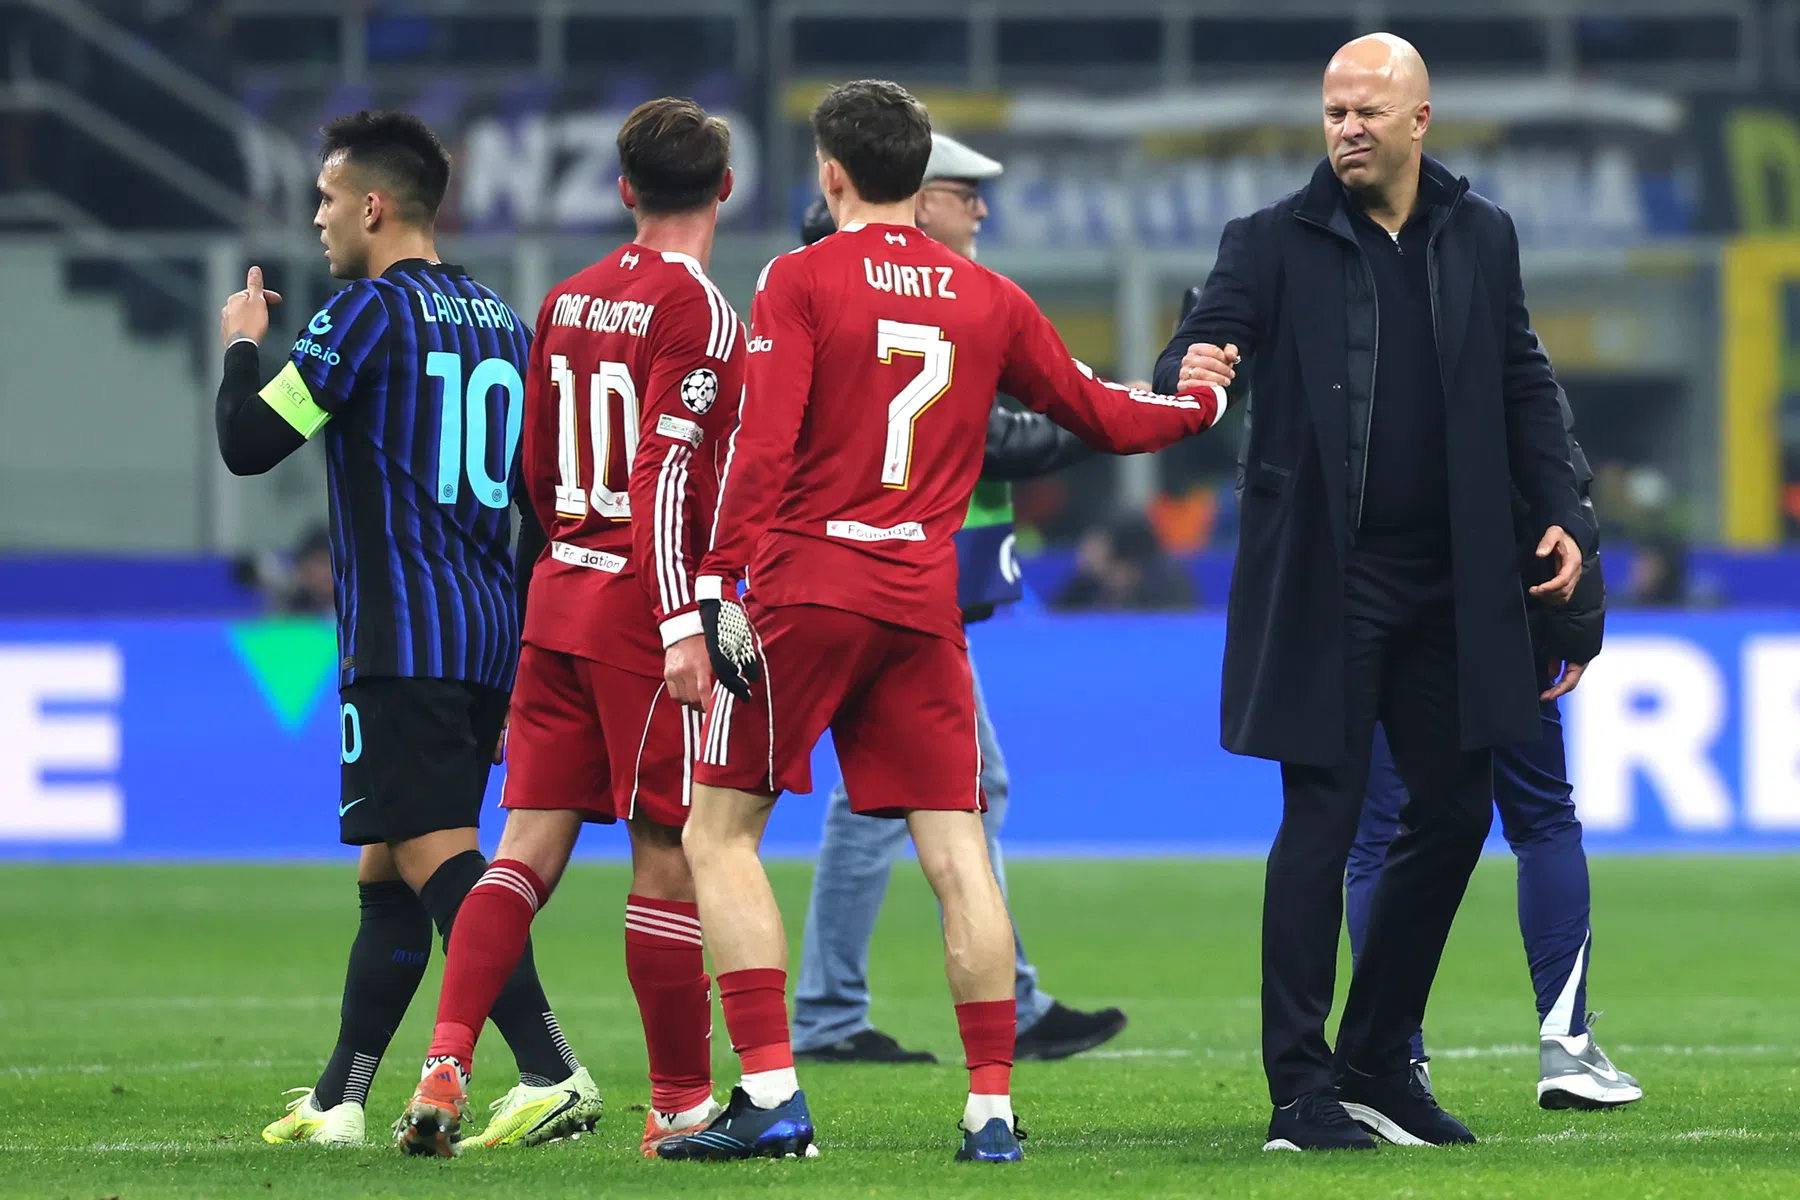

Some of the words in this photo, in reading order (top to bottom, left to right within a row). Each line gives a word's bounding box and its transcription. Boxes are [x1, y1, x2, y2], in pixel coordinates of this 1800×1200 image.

[864, 257, 957, 300] WIRTZ
[416, 290, 515, 332] LAUTARO
[552, 293, 590, 328] MAC
[276, 376, 307, 405] SPECT
[877, 318, 956, 491] 7
[426, 351, 524, 509] 10
[551, 354, 641, 522] 10
[563, 547, 620, 570] Fodation
[339, 702, 363, 767] 0
